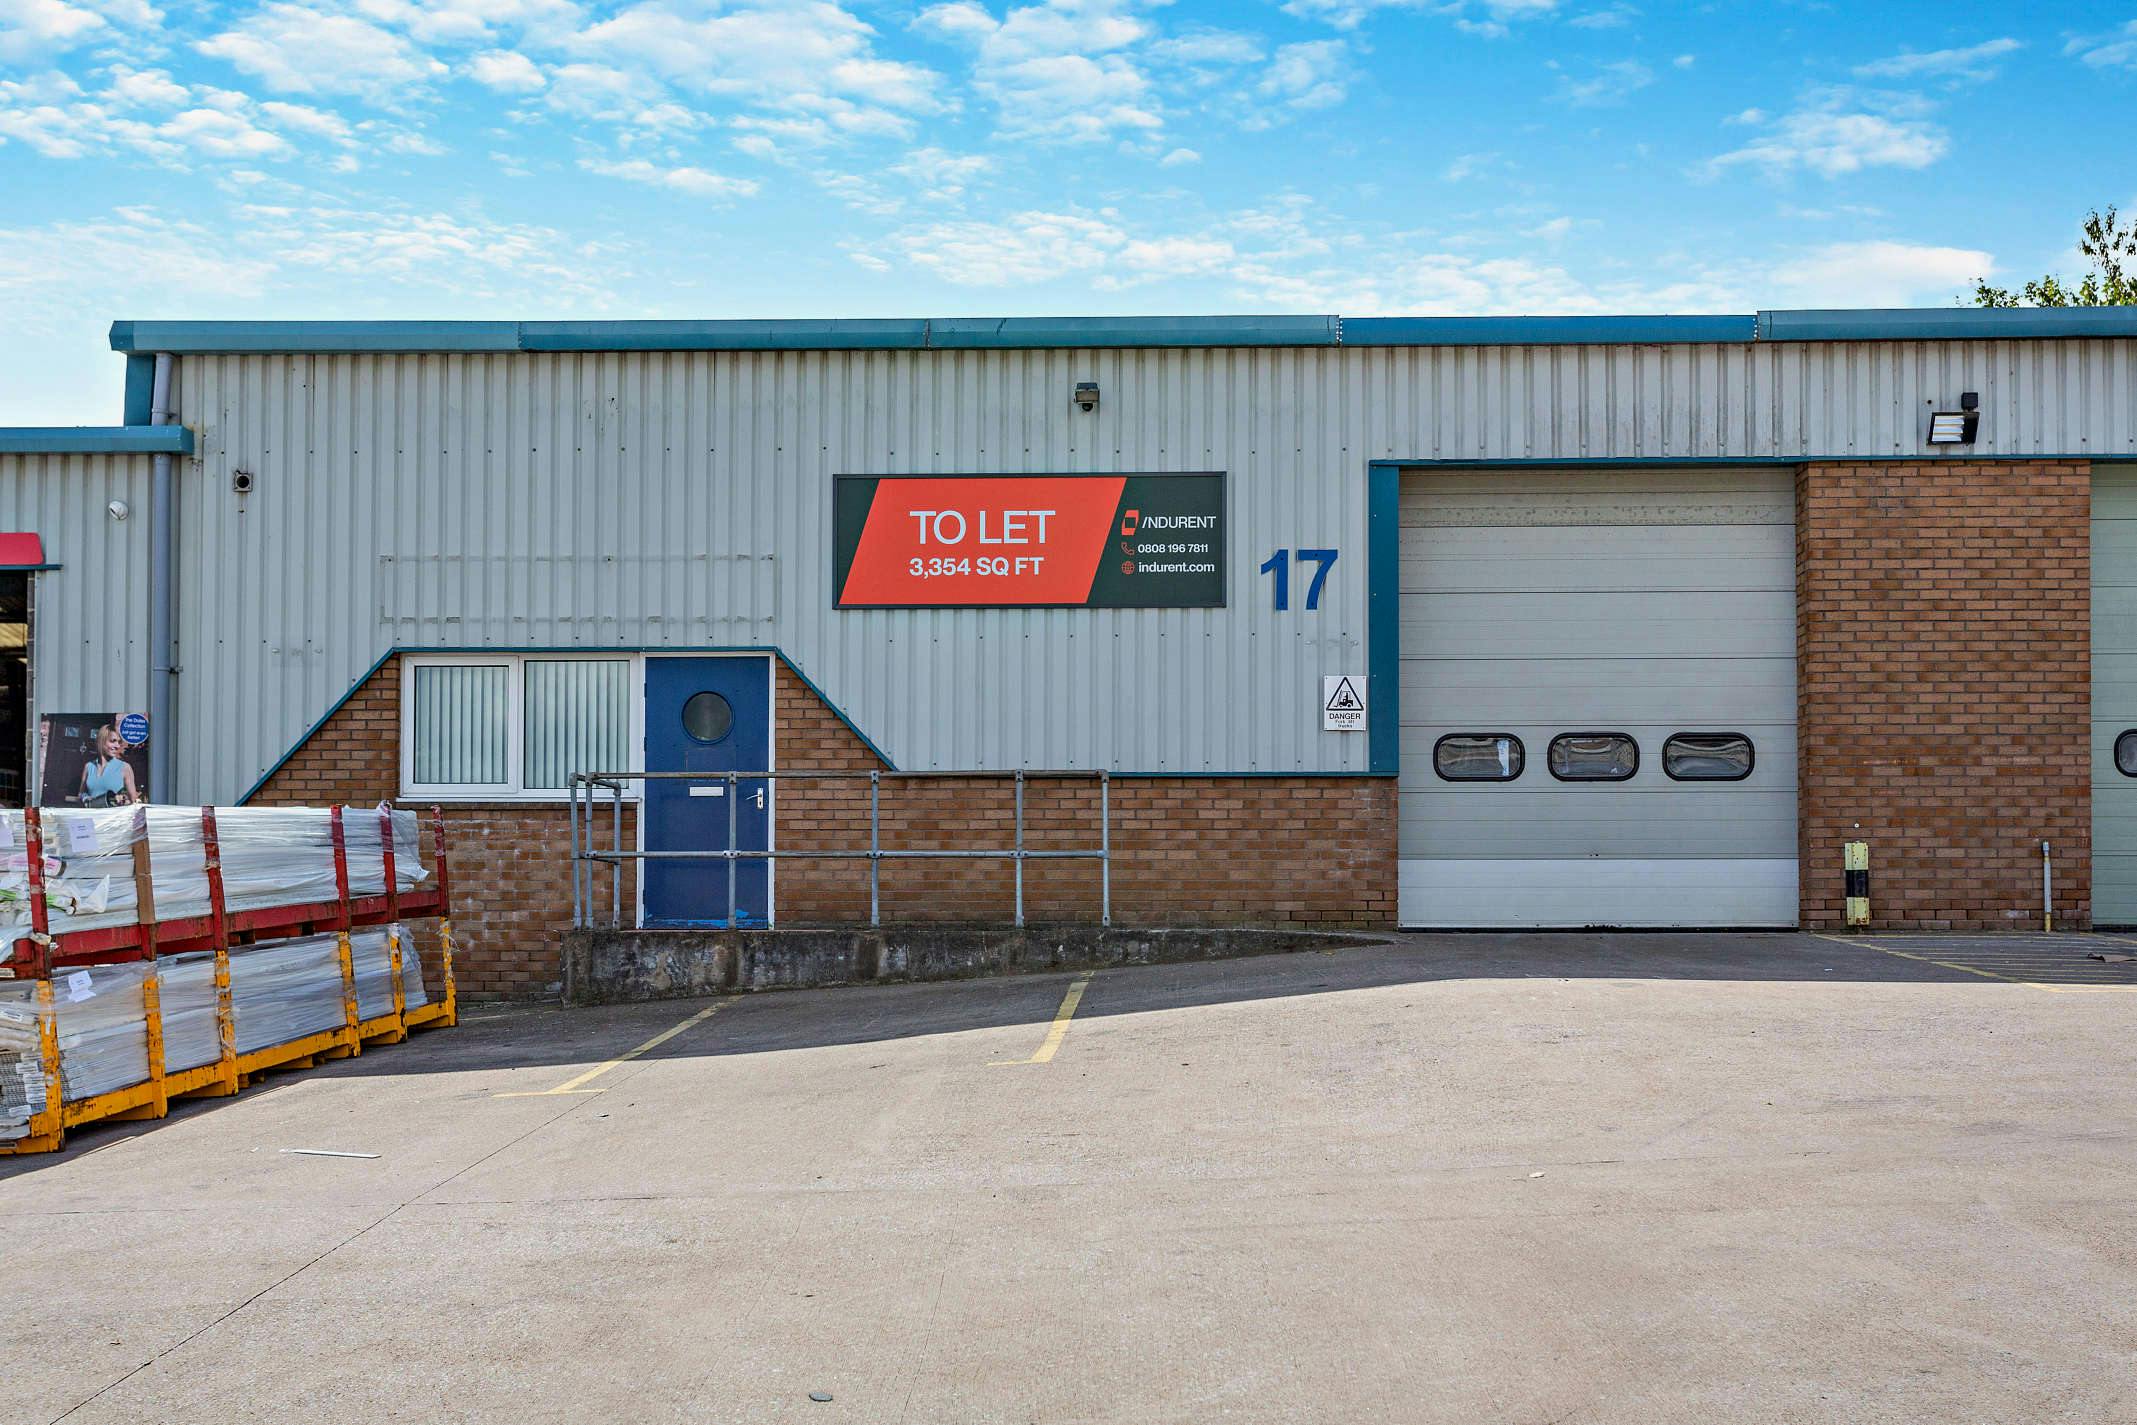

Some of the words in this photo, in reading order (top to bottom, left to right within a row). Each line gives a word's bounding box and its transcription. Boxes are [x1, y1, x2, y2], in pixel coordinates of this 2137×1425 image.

[909, 510, 967, 545] TO
[979, 510, 1056, 544] LET
[1137, 543, 1166, 553] 0808
[1167, 543, 1186, 553] 196
[1187, 543, 1209, 553] 7811
[909, 557, 971, 579] 3,354
[976, 557, 1010, 577] SQ
[1015, 557, 1045, 576] FT
[1138, 562, 1215, 573] indurent.com
[1260, 549, 1339, 611] 17
